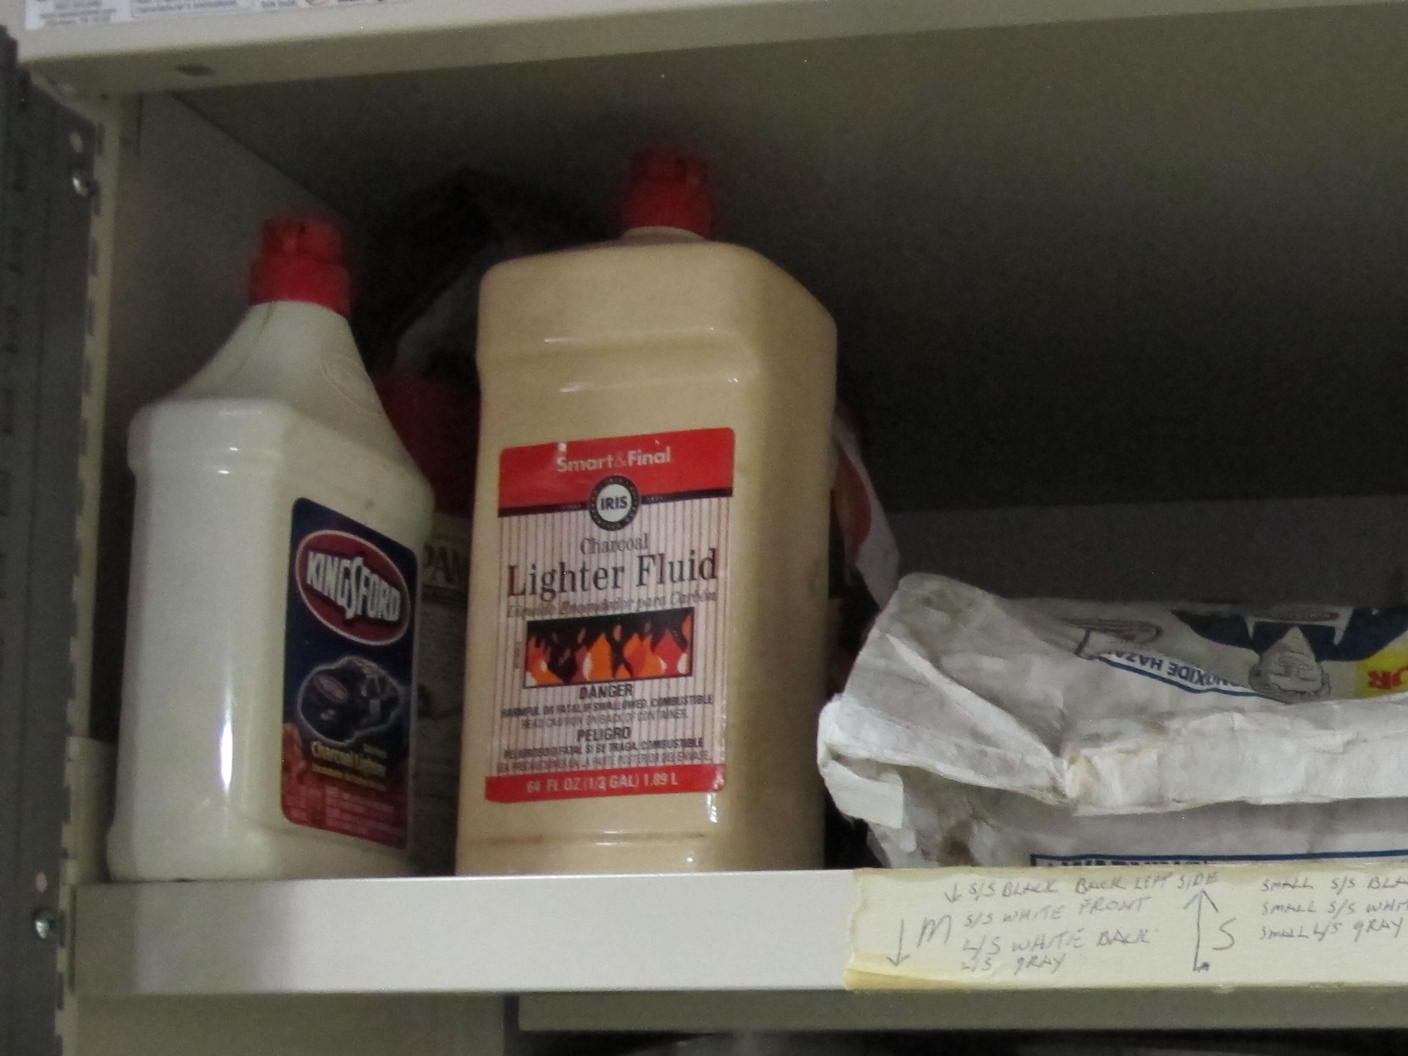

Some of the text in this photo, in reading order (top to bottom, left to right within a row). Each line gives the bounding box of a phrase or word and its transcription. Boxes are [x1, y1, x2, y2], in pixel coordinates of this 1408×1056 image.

[600, 496, 628, 511] IRIS
[580, 533, 649, 555] Charcoal
[507, 548, 718, 601] Lighter Fluid
[306, 551, 401, 622] KINGSFORD
[580, 684, 633, 699] DANGER
[577, 726, 631, 742] PELIGRO
[546, 779, 559, 792] FL
[564, 777, 582, 791] OZ
[609, 773, 639, 788] GAL)
[670, 772, 679, 785] L
[1176, 871, 1219, 890] SIDE
[1261, 878, 1314, 892] SMALL
[1002, 904, 1062, 923] WHITE
[1077, 896, 1152, 916] FRONT
[1261, 900, 1317, 915] SMALL
[1012, 928, 1085, 952] WHITE
[1097, 928, 1151, 947] BACK
[1260, 925, 1310, 940] SMALL
